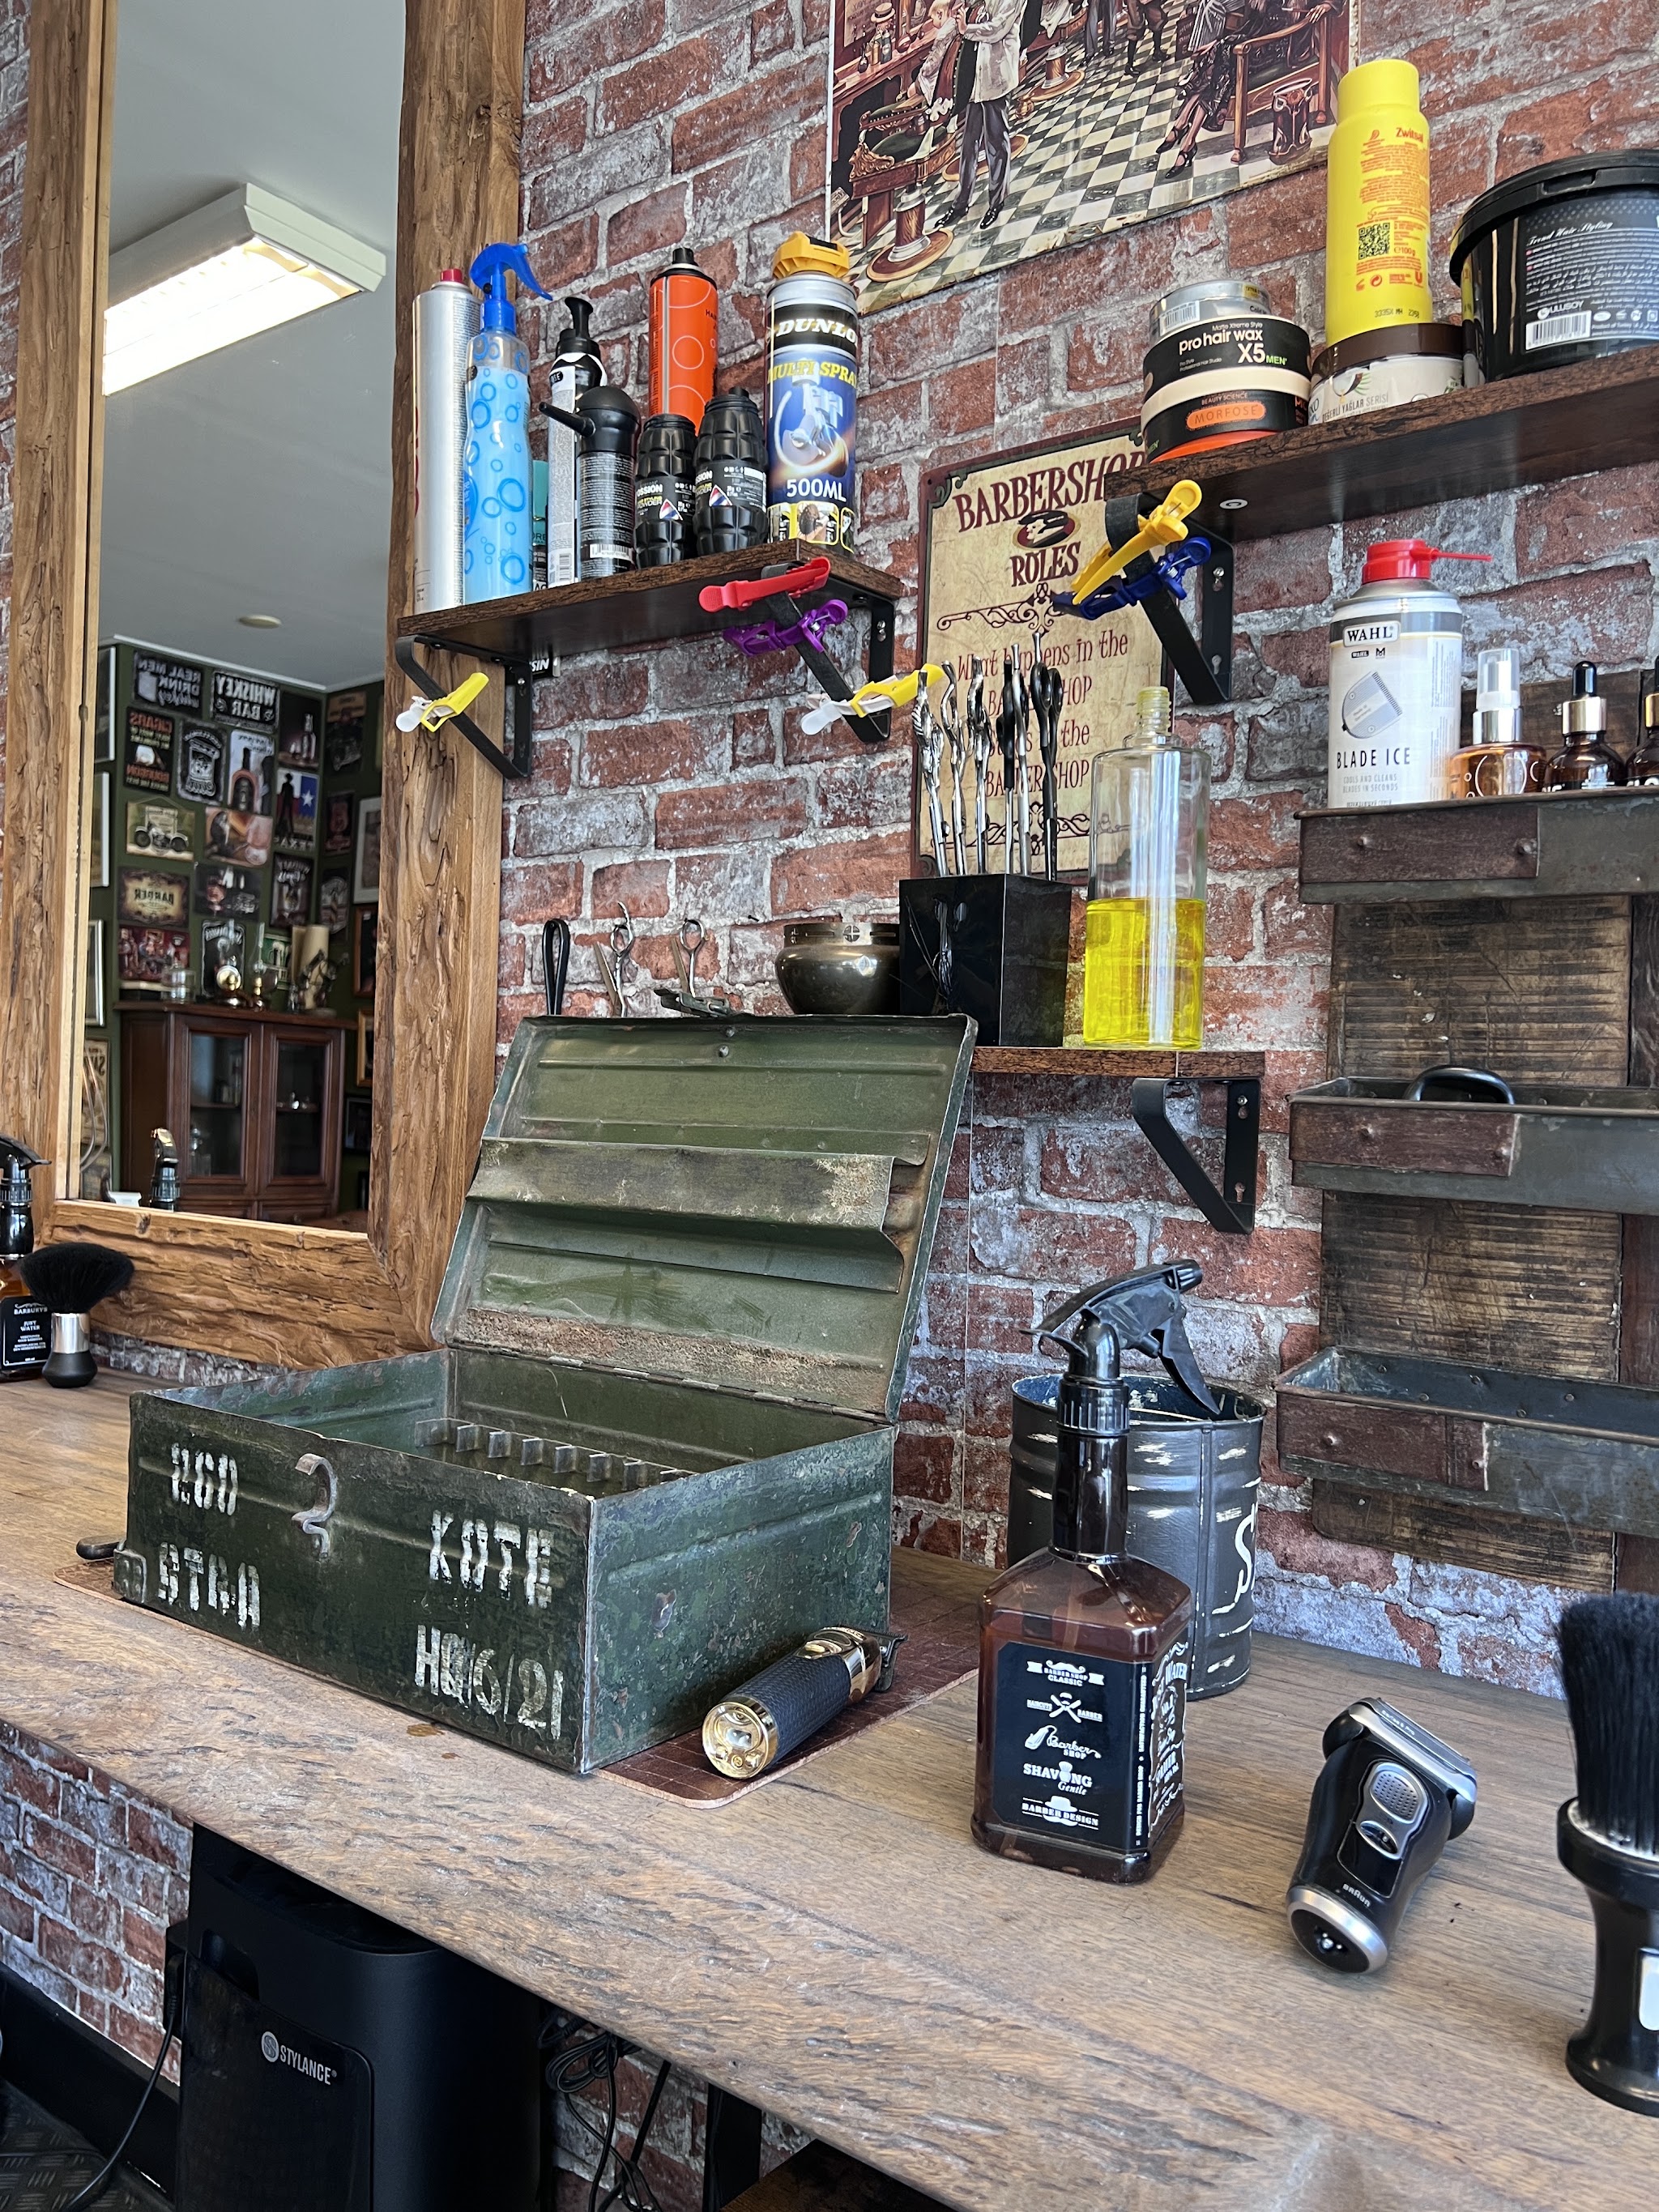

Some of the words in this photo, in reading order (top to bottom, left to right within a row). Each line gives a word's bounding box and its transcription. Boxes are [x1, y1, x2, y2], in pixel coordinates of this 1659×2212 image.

[1212, 323, 1228, 331] Matte
[1229, 322, 1250, 330] Xtreme
[1233, 330, 1264, 342] wax
[1238, 343, 1266, 364] X5
[1201, 396, 1222, 405] BEAUTY
[1223, 392, 1248, 401] SCIENCE
[1341, 398, 1364, 414] YAĞLAR
[1366, 392, 1389, 407] SERİSİ
[1194, 407, 1256, 424] MORFOSE
[787, 478, 847, 502] 500ML
[1347, 626, 1393, 642] WAHL
[1076, 638, 1093, 663] in
[1099, 629, 1128, 658] the
[1061, 719, 1090, 748] the
[1337, 749, 1377, 769] BLADE
[1386, 747, 1410, 766] ICE
[1374, 774, 1397, 782] CLEANS
[1371, 783, 1398, 792] SECONDS
[1047, 1674, 1083, 1687] CLASSIC
[1047, 1734, 1098, 1757] Barber
[1063, 1749, 1087, 1760] SHOP
[1057, 1781, 1087, 1796] Gentle
[1021, 1802, 1062, 1818] BARBER
[1063, 1811, 1099, 1826] DESIGN
[279, 2044, 332, 2086] STYLANCE
